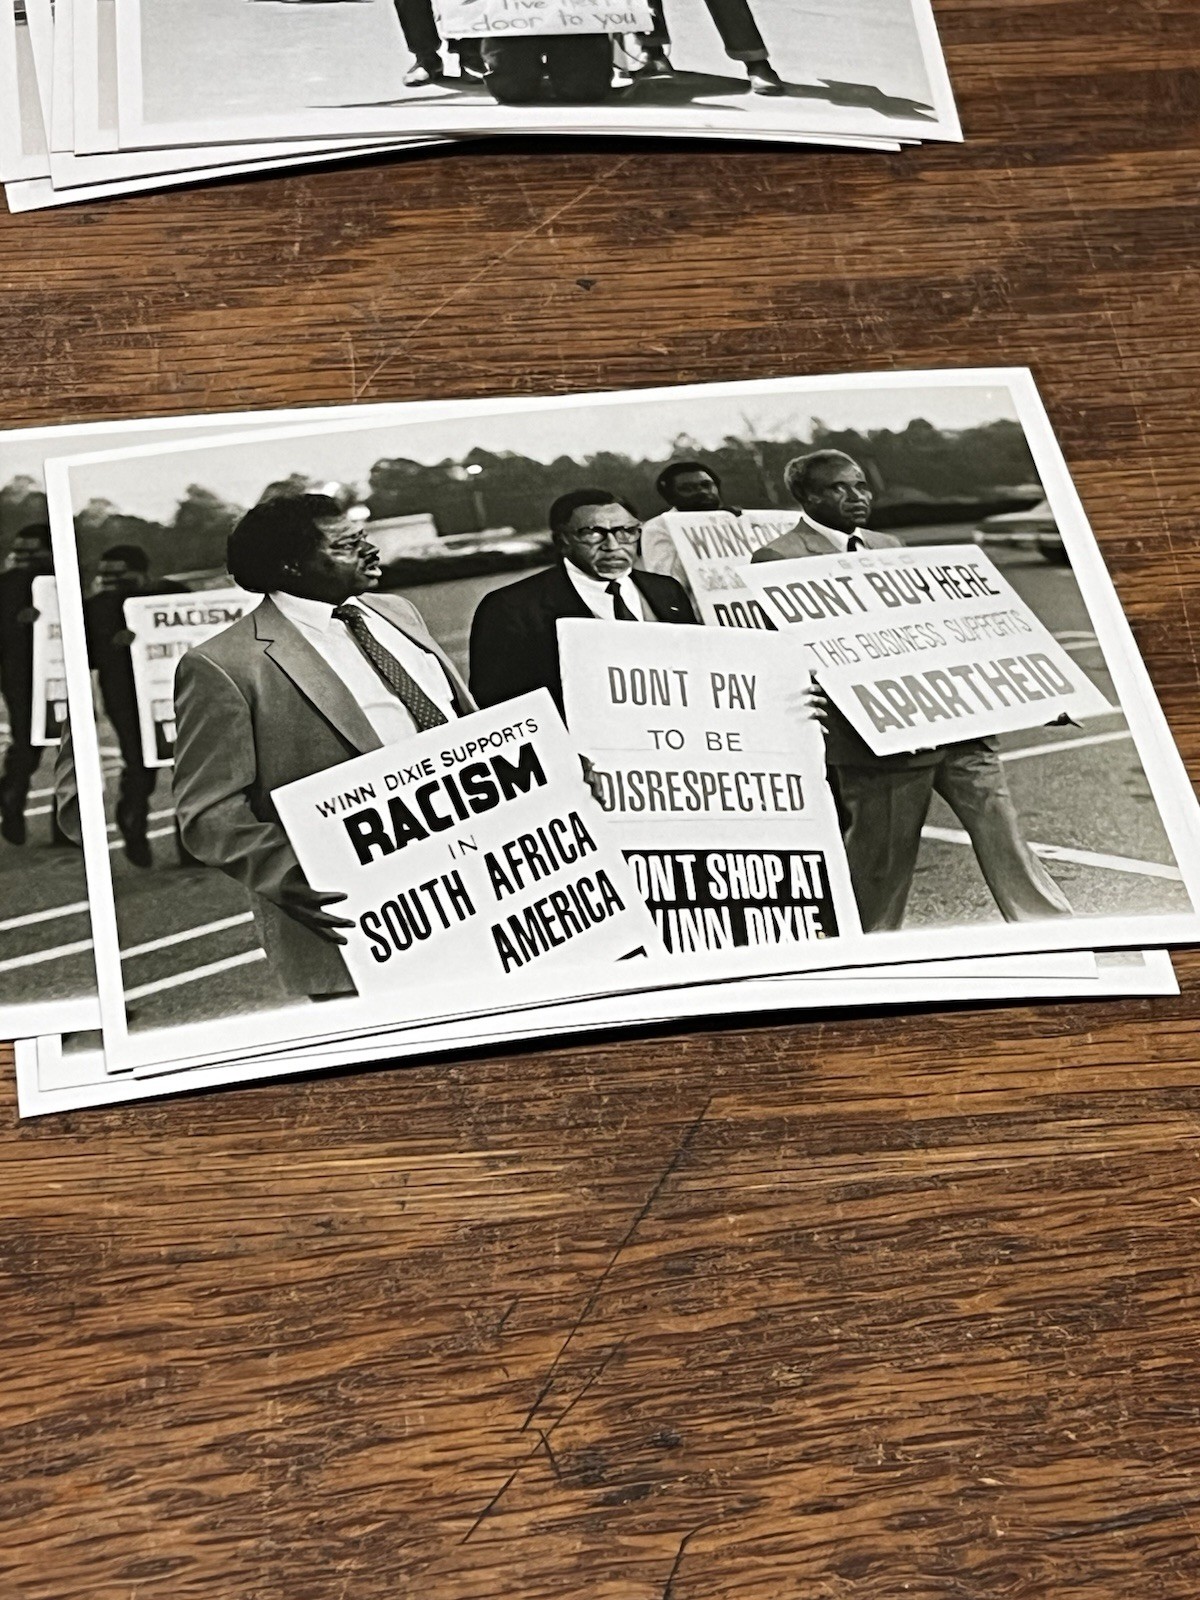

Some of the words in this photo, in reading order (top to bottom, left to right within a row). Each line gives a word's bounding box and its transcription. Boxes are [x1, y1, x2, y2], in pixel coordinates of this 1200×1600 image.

[471, 14, 543, 32] door
[558, 9, 583, 27] to
[592, 12, 637, 30] you
[863, 567, 934, 608] BUY
[927, 563, 1001, 599] HERE
[153, 608, 243, 628] RACISM
[804, 637, 860, 668] THIS
[855, 622, 947, 659] BUSINESS
[943, 609, 1032, 643] SUPPORTS
[710, 672, 757, 710] PAY
[851, 653, 1075, 733] APARTHEID
[647, 729, 685, 749] TO
[705, 731, 743, 751] BE
[315, 782, 377, 818] WINN
[384, 758, 436, 791] DIXIE
[441, 718, 539, 767] SUPPORTS
[343, 742, 548, 866] RACISM
[599, 770, 805, 812] DISRESPECTED
[448, 834, 479, 860] IN
[359, 870, 476, 963] SOUTH
[484, 811, 598, 901] AFRICA
[706, 853, 785, 900] SHOP
[791, 853, 824, 900] AT
[491, 869, 626, 973] AMERICA
[744, 905, 823, 945] DIXIE
